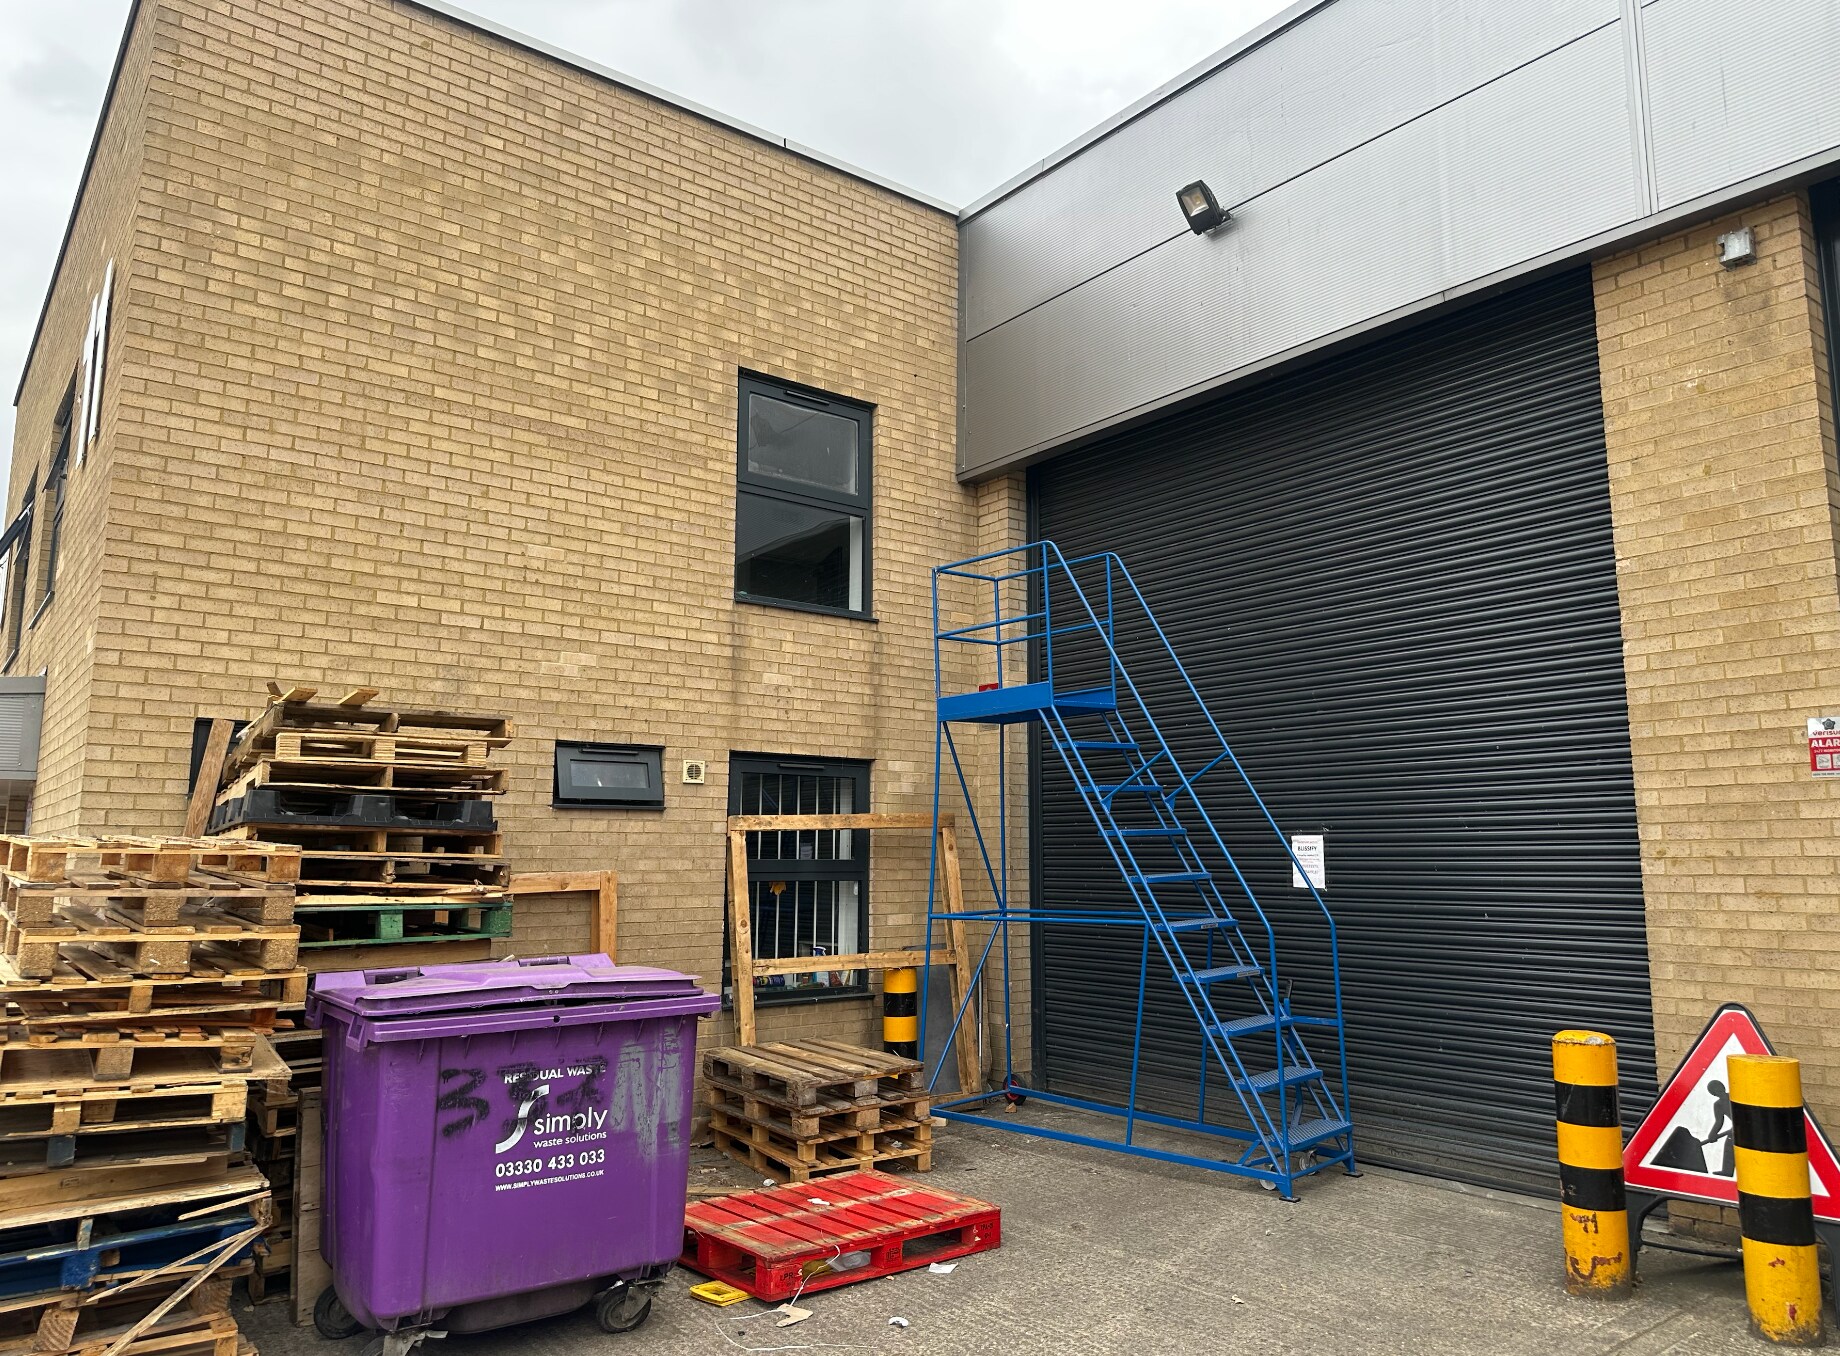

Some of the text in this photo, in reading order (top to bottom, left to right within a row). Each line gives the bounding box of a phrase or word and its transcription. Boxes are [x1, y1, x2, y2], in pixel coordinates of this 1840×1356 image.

[504, 1062, 607, 1084] RESDUAL WASE
[533, 1106, 608, 1135] simply
[533, 1131, 607, 1149] waste solutions
[495, 1149, 605, 1178] 03330 433 033
[495, 1169, 605, 1192] WWW.SIMPLYWASTESOLUTIONS.CO.UK
